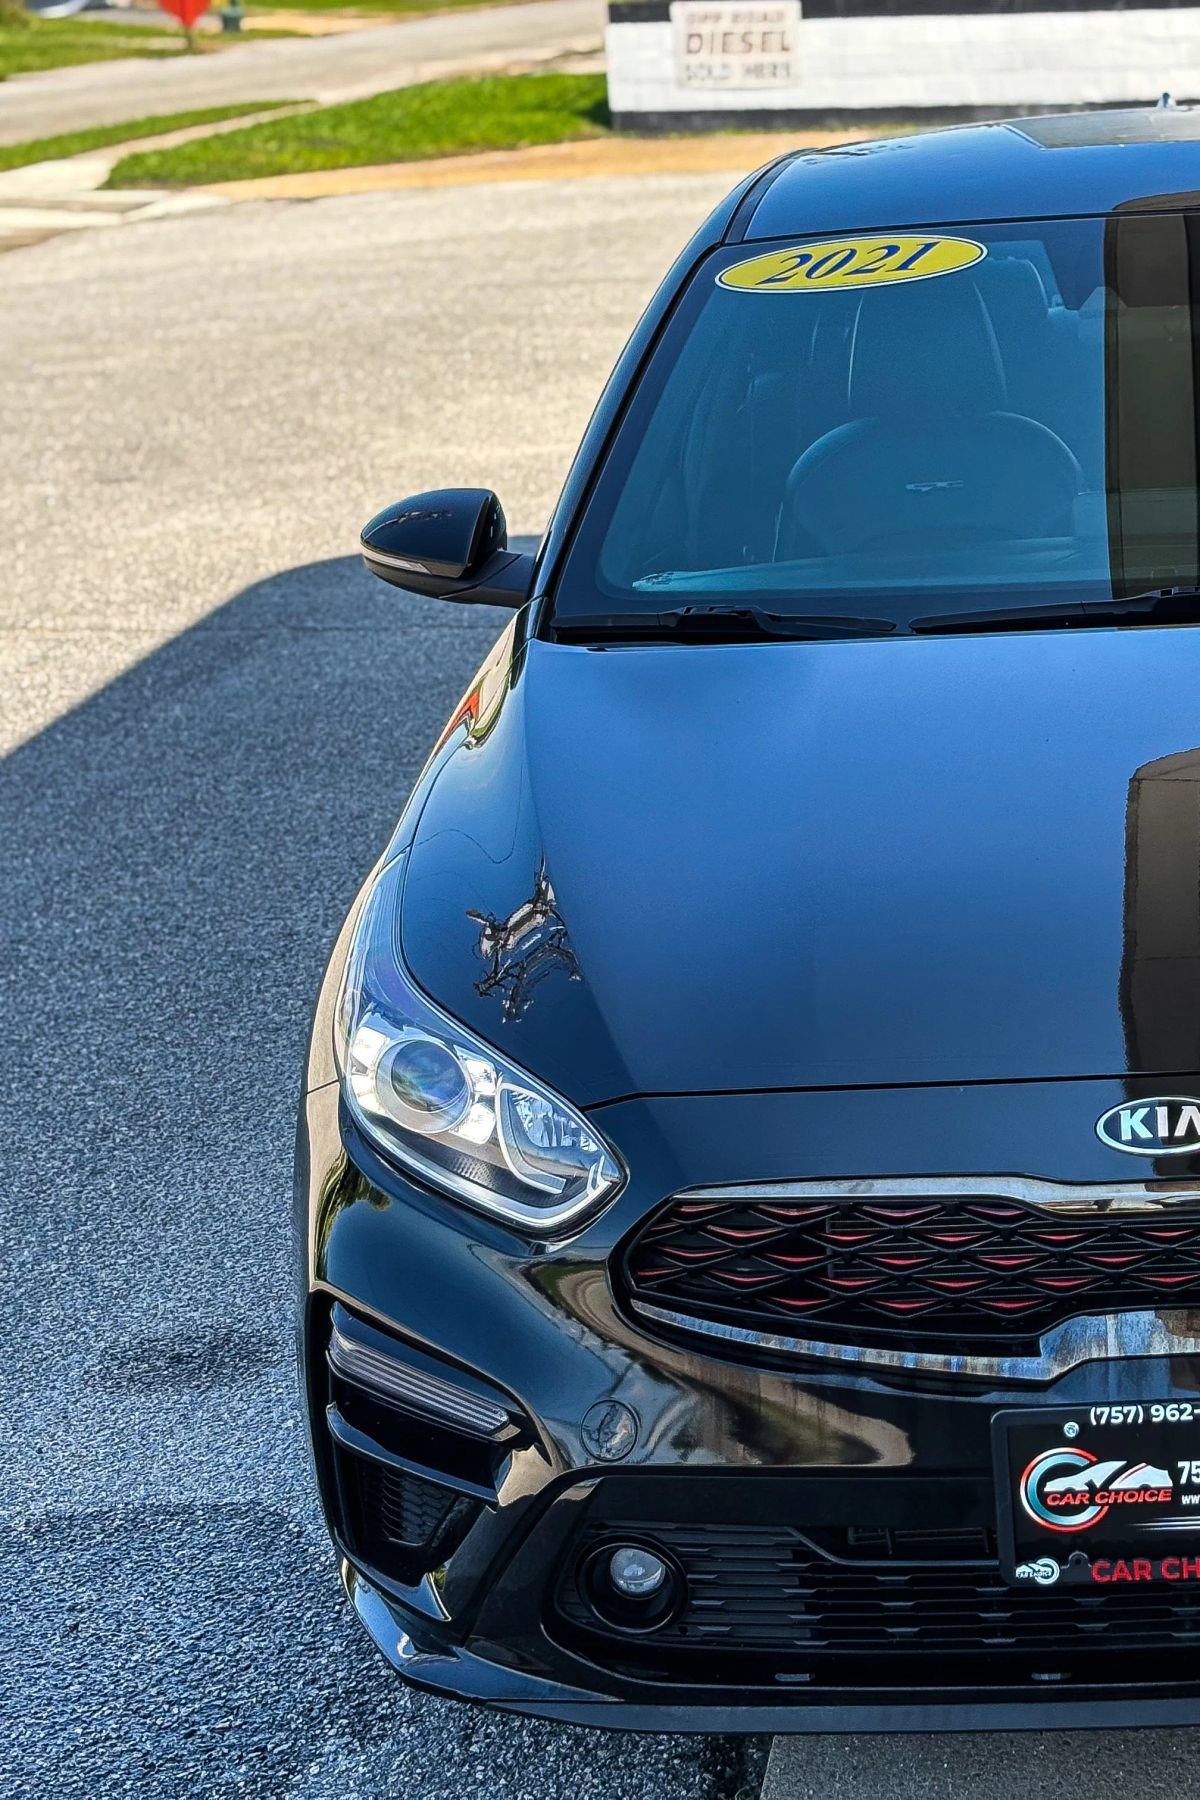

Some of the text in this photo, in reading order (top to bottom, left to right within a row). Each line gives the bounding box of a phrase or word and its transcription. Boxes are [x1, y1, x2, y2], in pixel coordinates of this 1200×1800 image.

[687, 31, 790, 54] DIESEL
[754, 240, 942, 286] 2021
[1090, 1405, 1144, 1426] (757)
[1046, 1489, 1173, 1506] CAR CHOICE
[1091, 1559, 1152, 1583] CAR
